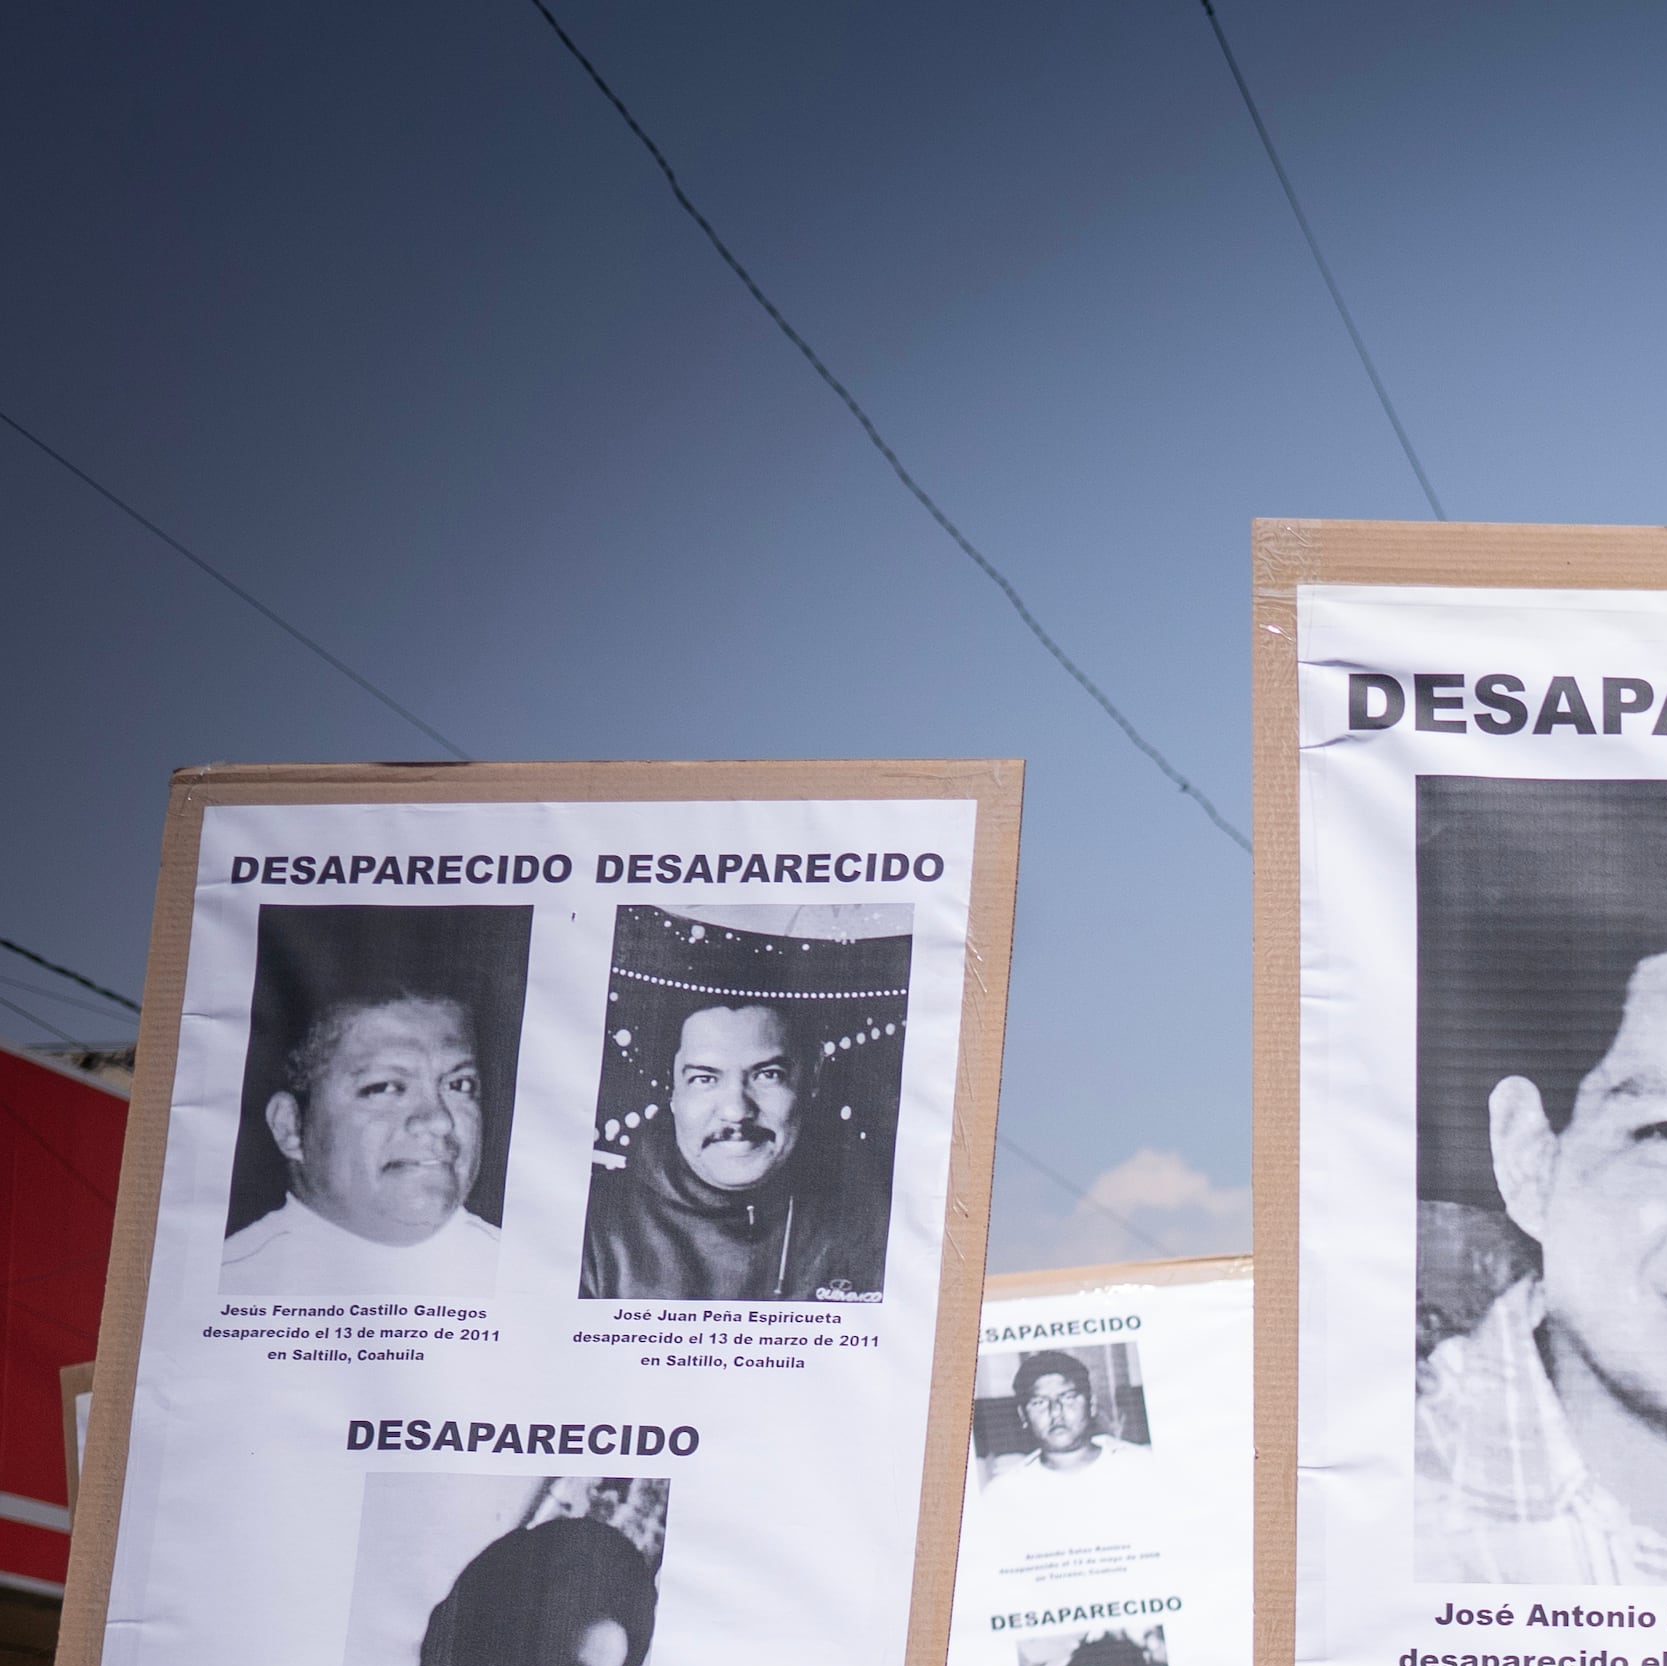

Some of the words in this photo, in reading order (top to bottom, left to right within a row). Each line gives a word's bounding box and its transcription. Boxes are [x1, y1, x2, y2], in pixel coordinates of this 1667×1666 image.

[230, 854, 573, 886] DESAPARECIDO
[595, 852, 944, 884] DESAPARECIDO
[220, 1303, 267, 1317] Jesús
[272, 1304, 345, 1317] Fernando
[349, 1303, 408, 1317] Castillo
[414, 1304, 487, 1322] Gallegos
[613, 1308, 652, 1321] José
[657, 1309, 697, 1322] Juan
[703, 1310, 742, 1322] Peña
[748, 1311, 842, 1326] Espiricueta
[202, 1325, 310, 1341] desaparecido
[315, 1327, 330, 1339] el
[335, 1327, 352, 1339] 13
[356, 1326, 375, 1339] de
[379, 1329, 429, 1339] marzo
[434, 1327, 455, 1340] de
[459, 1329, 499, 1342] 2011
[572, 1331, 683, 1346] desaparecido
[688, 1332, 703, 1345] el
[709, 1332, 728, 1345] 13
[733, 1333, 753, 1345] de
[759, 1336, 808, 1346] marzo
[813, 1334, 834, 1346] de
[839, 1335, 878, 1347] 2011
[267, 1351, 287, 1360] en
[292, 1349, 352, 1364] Saltillo,
[357, 1348, 424, 1361] Coahuila
[640, 1357, 660, 1366] en
[666, 1354, 727, 1370] Saltillo,
[733, 1355, 805, 1369] Coahuila
[346, 1419, 700, 1457] DESAPARECIDO
[990, 1596, 1183, 1631] DESAPARECIDO
[1434, 1602, 1515, 1626] José
[1526, 1603, 1656, 1628] Antonio
